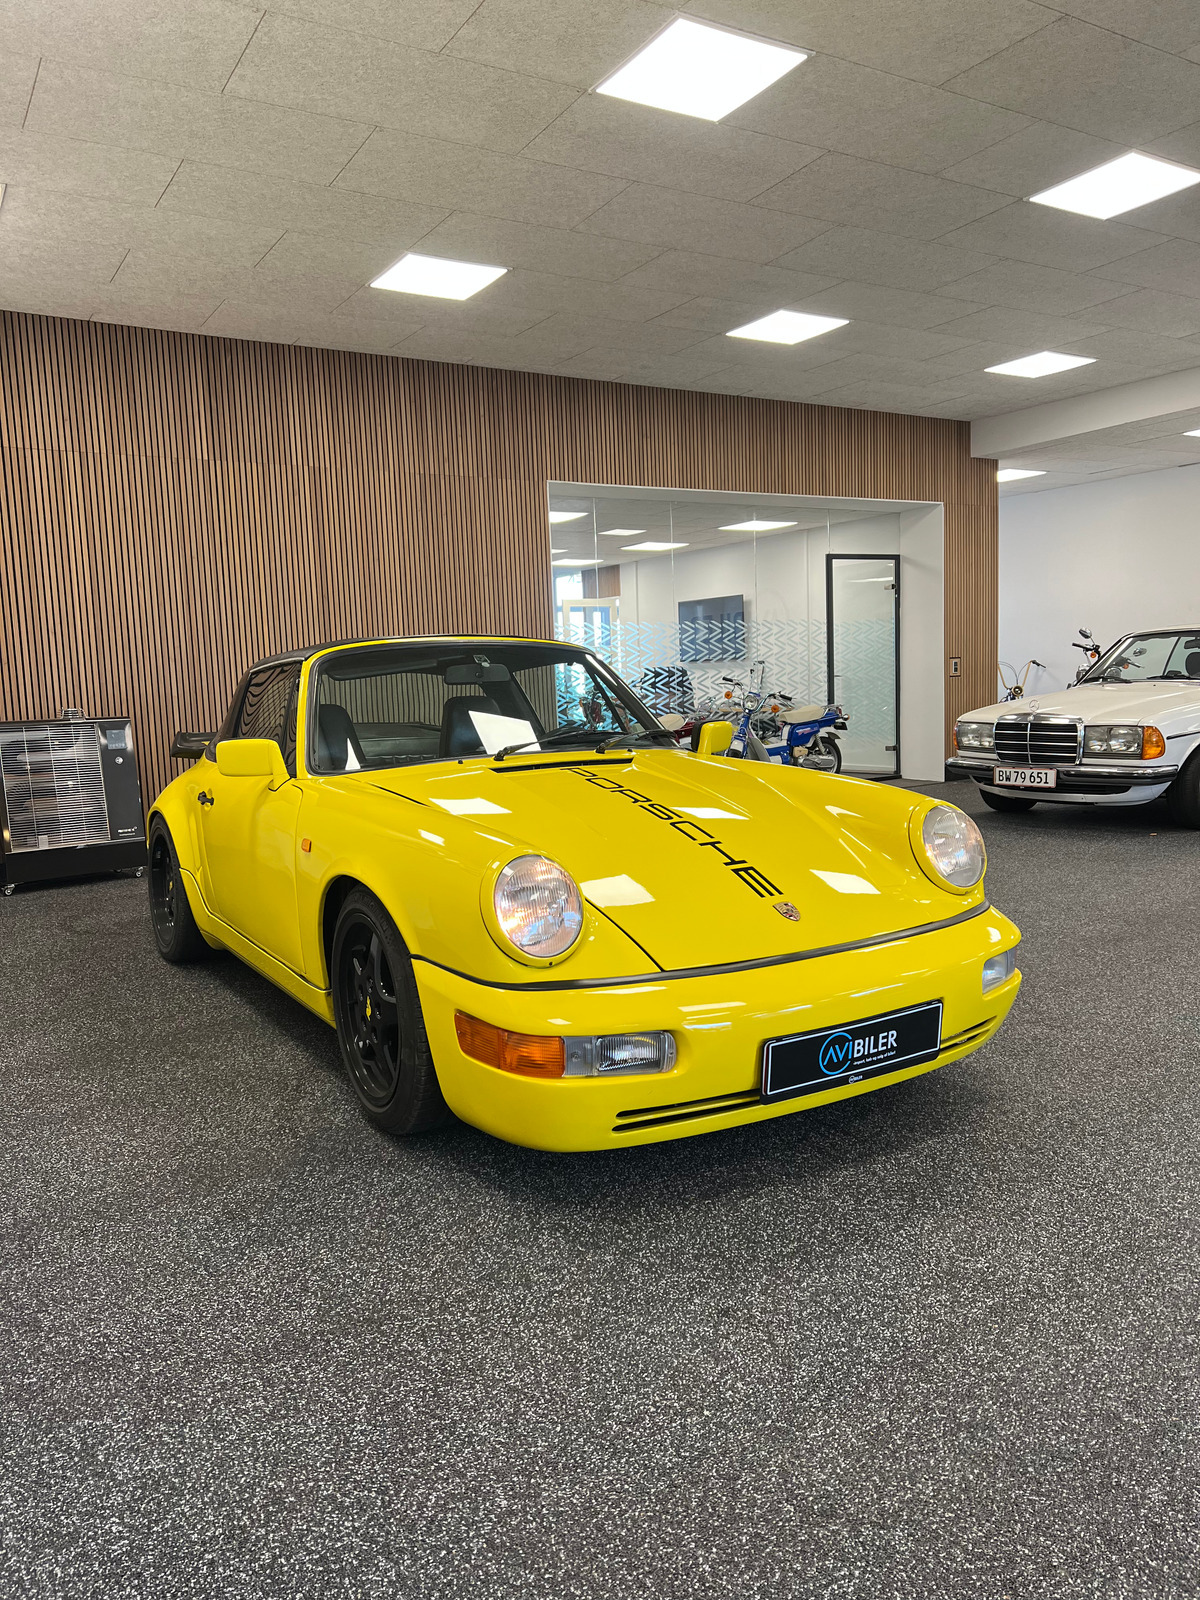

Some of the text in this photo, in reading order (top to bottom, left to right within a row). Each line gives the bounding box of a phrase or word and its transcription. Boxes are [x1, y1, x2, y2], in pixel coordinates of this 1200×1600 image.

[998, 770, 1049, 784] BW 79 651
[560, 767, 784, 898] PORSCHE
